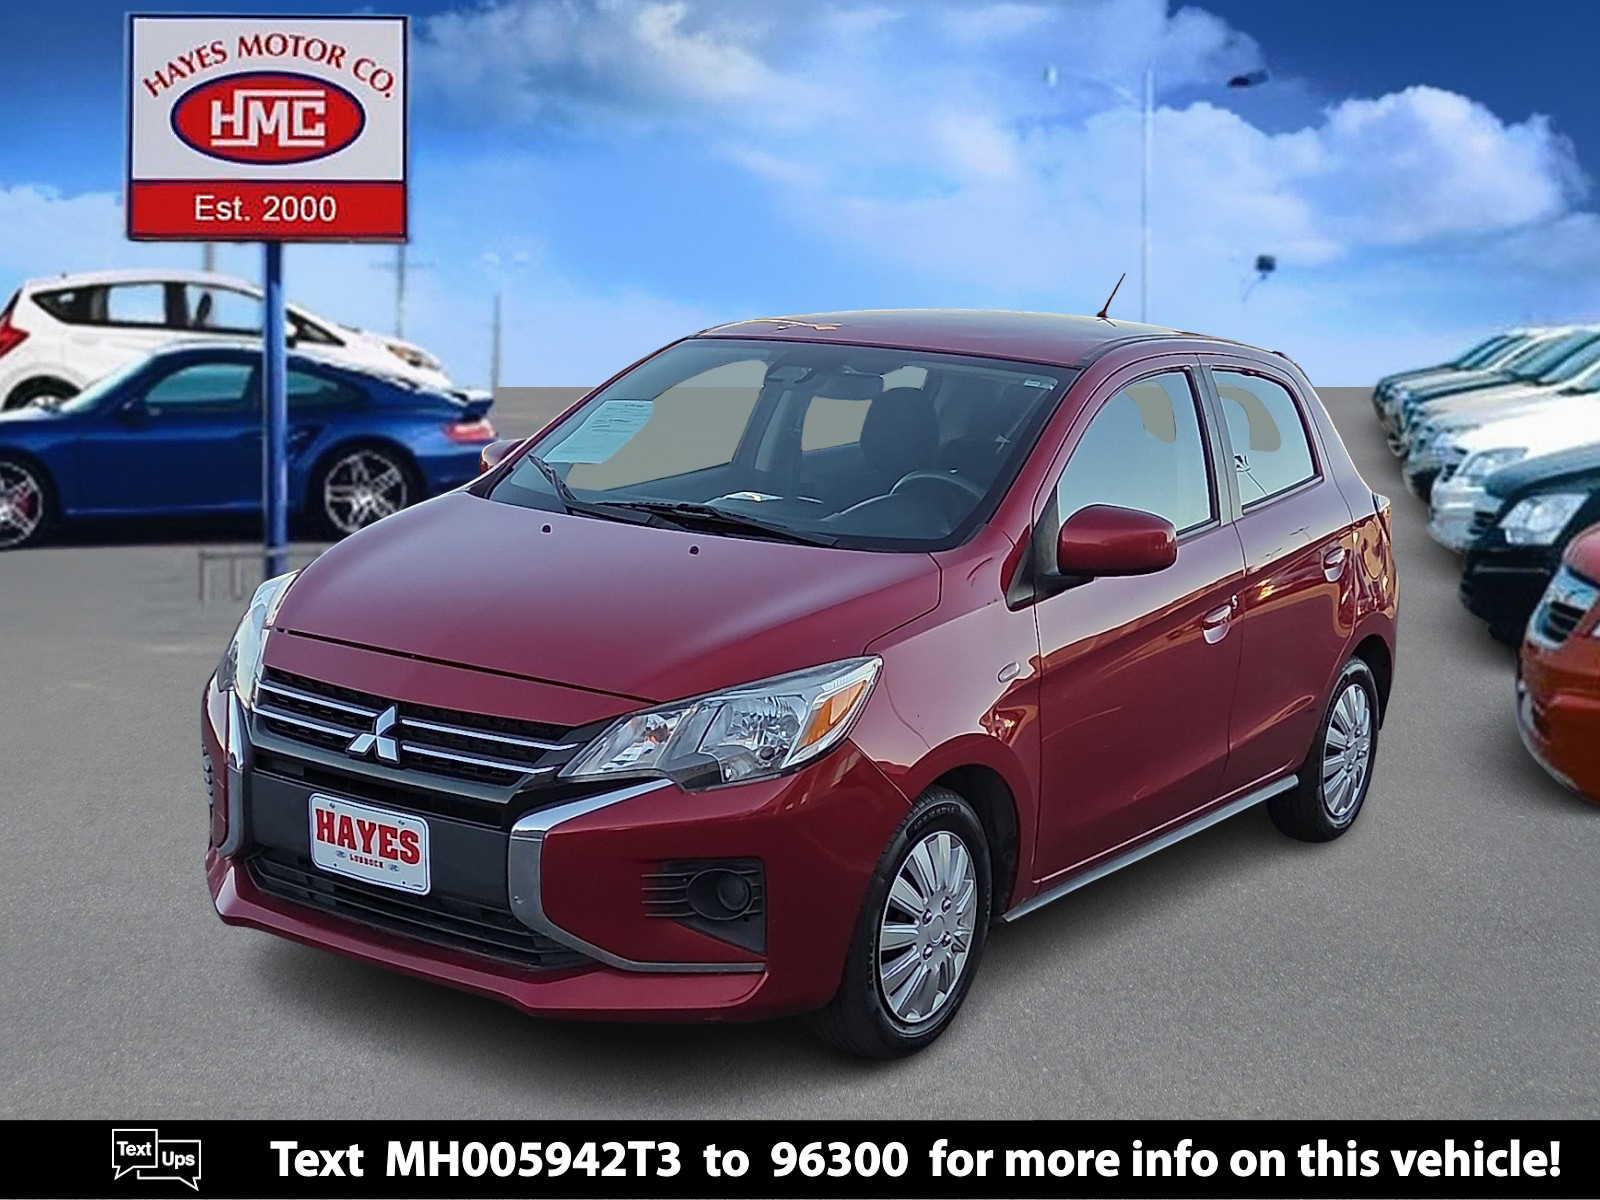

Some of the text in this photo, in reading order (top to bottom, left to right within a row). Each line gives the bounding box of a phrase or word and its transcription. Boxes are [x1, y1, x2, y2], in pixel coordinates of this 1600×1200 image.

[143, 33, 394, 98] HAYES MOTOR CO.
[210, 89, 326, 147] HMC
[195, 195, 337, 222] Est. 2000
[315, 808, 420, 865] HAYES
